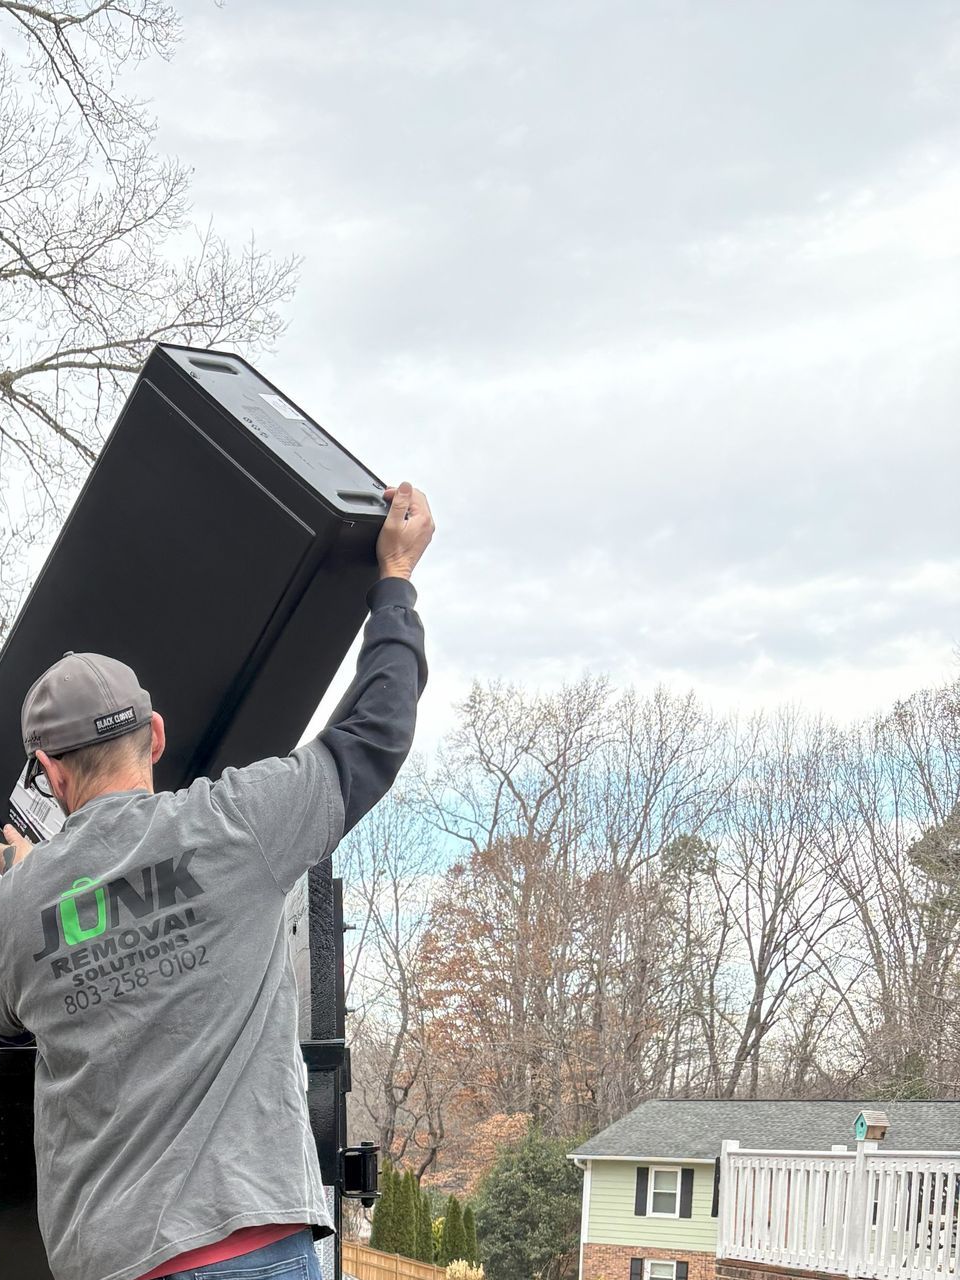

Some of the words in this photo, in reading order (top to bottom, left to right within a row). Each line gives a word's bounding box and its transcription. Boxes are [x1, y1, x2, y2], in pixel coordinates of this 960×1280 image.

[96, 717, 114, 730] BLACK
[33, 848, 205, 962] JUNK
[50, 907, 207, 979] REMOVAL
[72, 934, 189, 987] SOLUTIONS
[64, 945, 209, 1015] 803-258-0102
